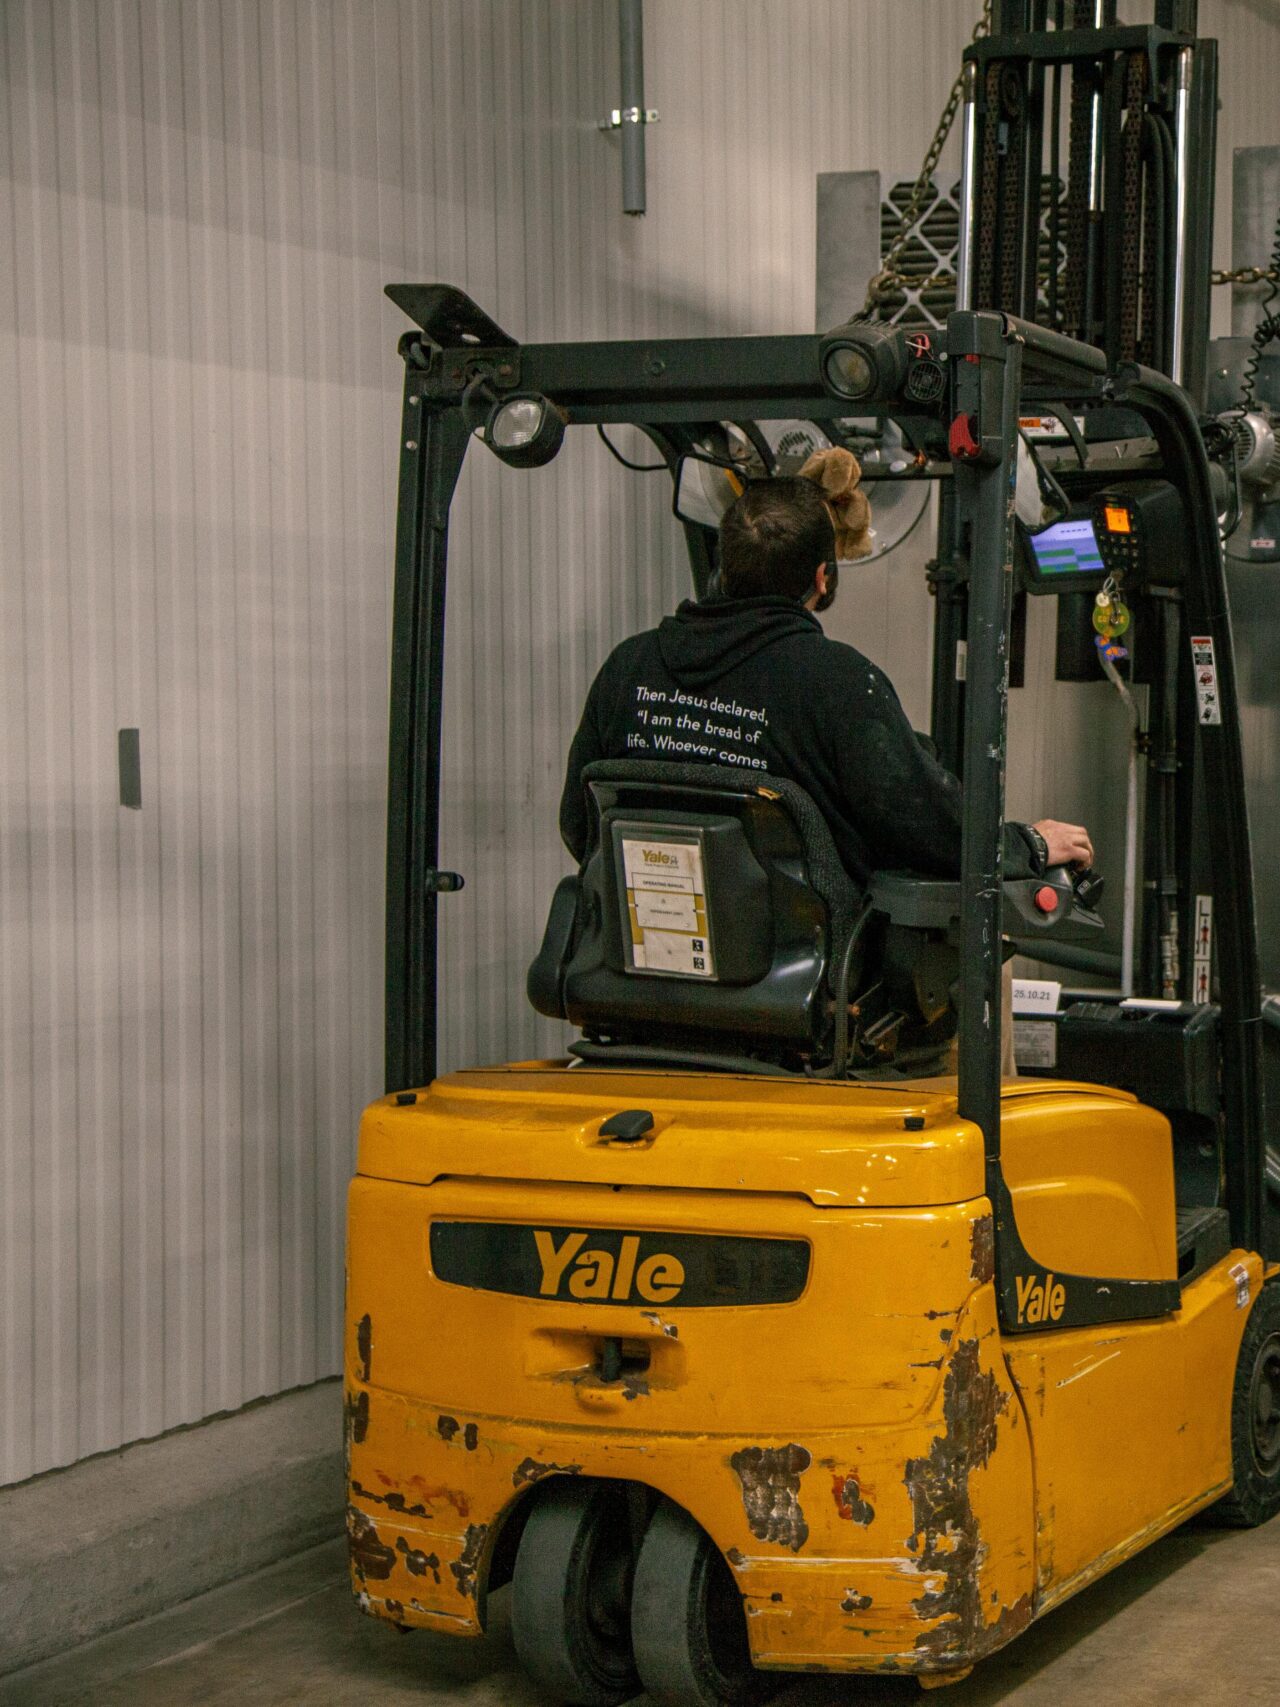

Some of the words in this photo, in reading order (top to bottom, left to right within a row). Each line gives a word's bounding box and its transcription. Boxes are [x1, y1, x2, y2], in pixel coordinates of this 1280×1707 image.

[636, 686, 666, 701] Then
[669, 688, 708, 709] Jesus
[710, 697, 768, 726] declared,
[651, 715, 672, 726] am
[676, 714, 700, 731] the
[705, 719, 741, 740] bread
[745, 730, 762, 744] of
[627, 733, 650, 748] life.
[653, 734, 717, 756] Whoever
[719, 751, 768, 770] comes
[642, 849, 670, 864] Yale
[533, 1230, 685, 1303] Yale
[1015, 1274, 1066, 1324] Yale
